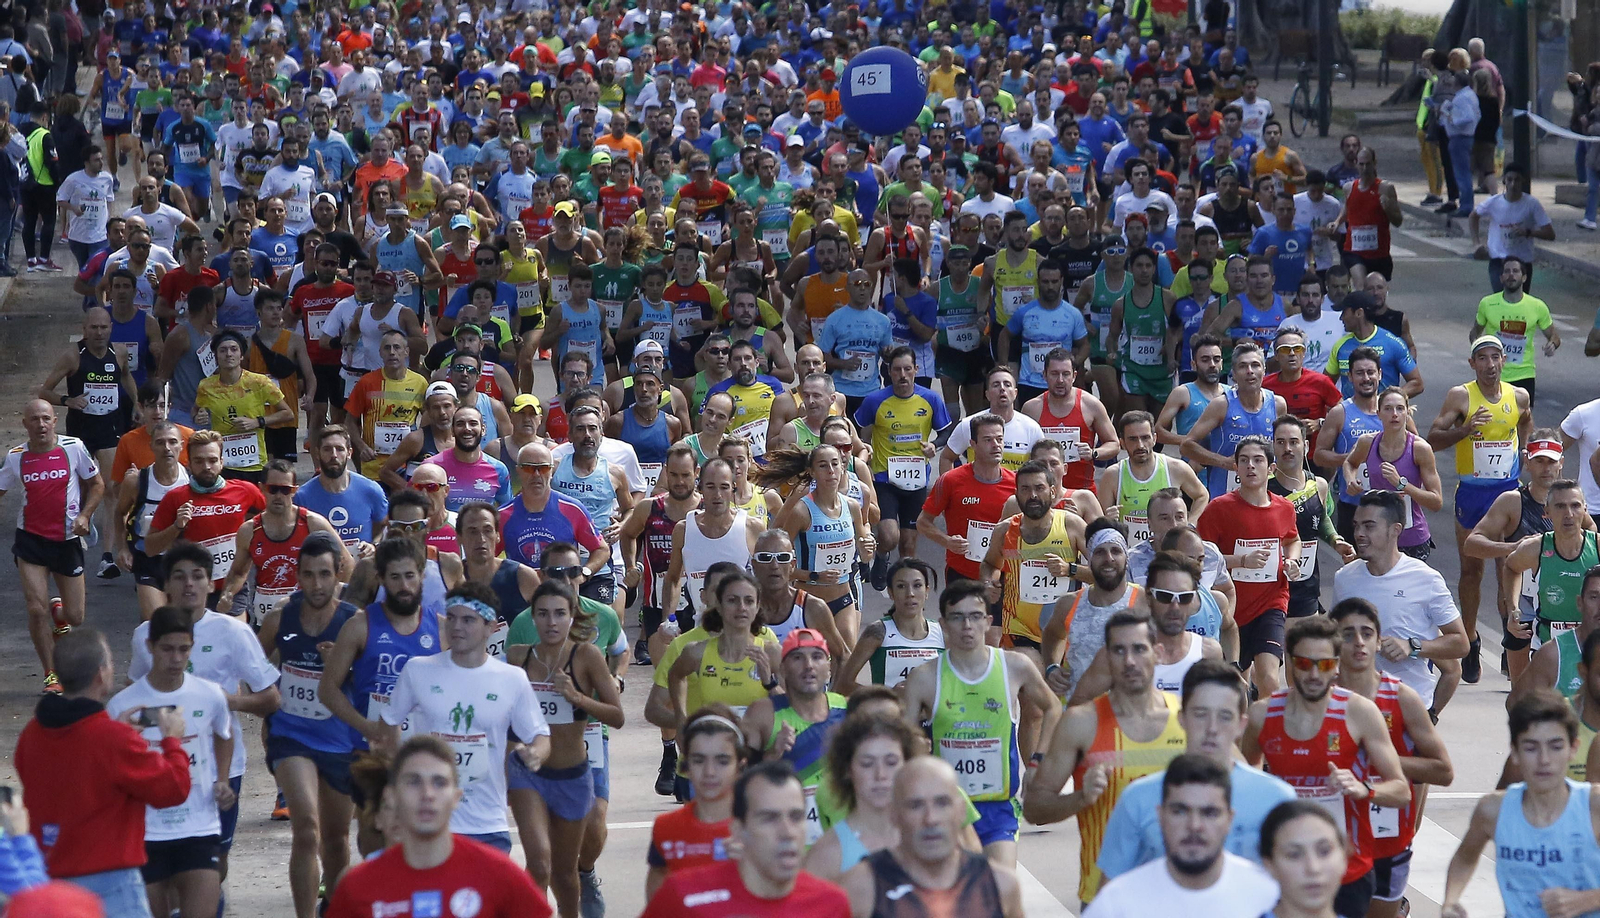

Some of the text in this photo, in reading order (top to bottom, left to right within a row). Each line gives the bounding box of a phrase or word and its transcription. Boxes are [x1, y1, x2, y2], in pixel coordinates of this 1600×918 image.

[84, 205, 98, 213] 738
[380, 248, 403, 258] nerja
[519, 289, 534, 299] 201
[646, 312, 668, 320] nerja
[649, 331, 665, 341] 302
[956, 333, 973, 343] 498
[1138, 346, 1155, 354] 280
[89, 395, 114, 404] 6424
[384, 433, 403, 443] 374
[225, 445, 257, 458] 18600
[1488, 454, 1502, 465] 77
[23, 469, 68, 483] DCOOP
[895, 469, 920, 479] 9112
[559, 480, 594, 493] nerja
[962, 497, 980, 505] CAIM
[812, 519, 850, 534] nerja
[981, 536, 992, 548] 8
[826, 552, 847, 566] 353
[1032, 576, 1058, 588] 214
[288, 685, 315, 702] 183
[954, 759, 986, 775] 408
[806, 807, 818, 822] 4
[1500, 844, 1564, 868] nerja
